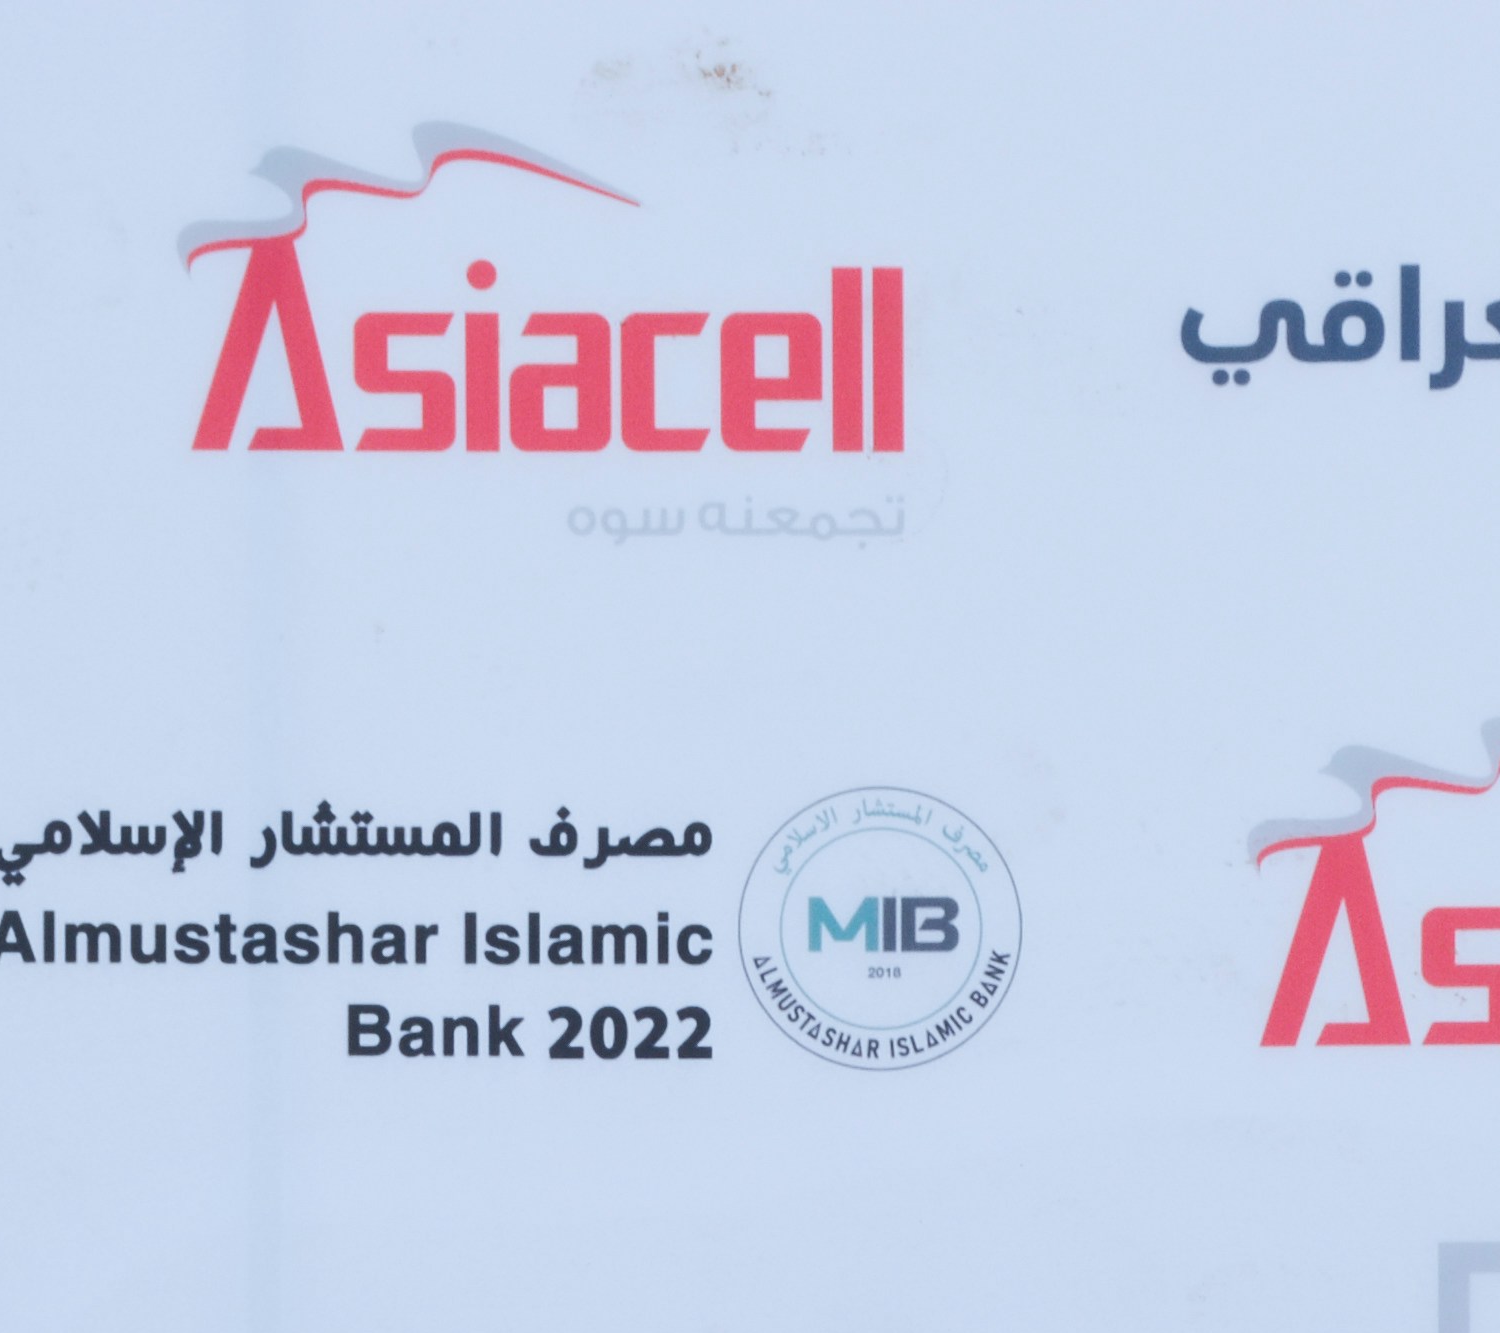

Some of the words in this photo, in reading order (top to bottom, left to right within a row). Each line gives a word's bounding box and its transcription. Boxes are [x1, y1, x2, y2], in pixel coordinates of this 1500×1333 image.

[193, 240, 904, 452] Asiacell
[568, 507, 684, 544] سوه
[250, 800, 502, 869] المستشار
[529, 806, 712, 869] مصرف
[464, 912, 712, 965] Islamic
[808, 896, 960, 952] MIB
[348, 1004, 524, 1057] Bank
[548, 1006, 712, 1060] 2022
[753, 954, 879, 1059] ALMUSTASHAR
[889, 1006, 973, 1058] ISLAMIC
[970, 949, 1011, 1008] BANK
